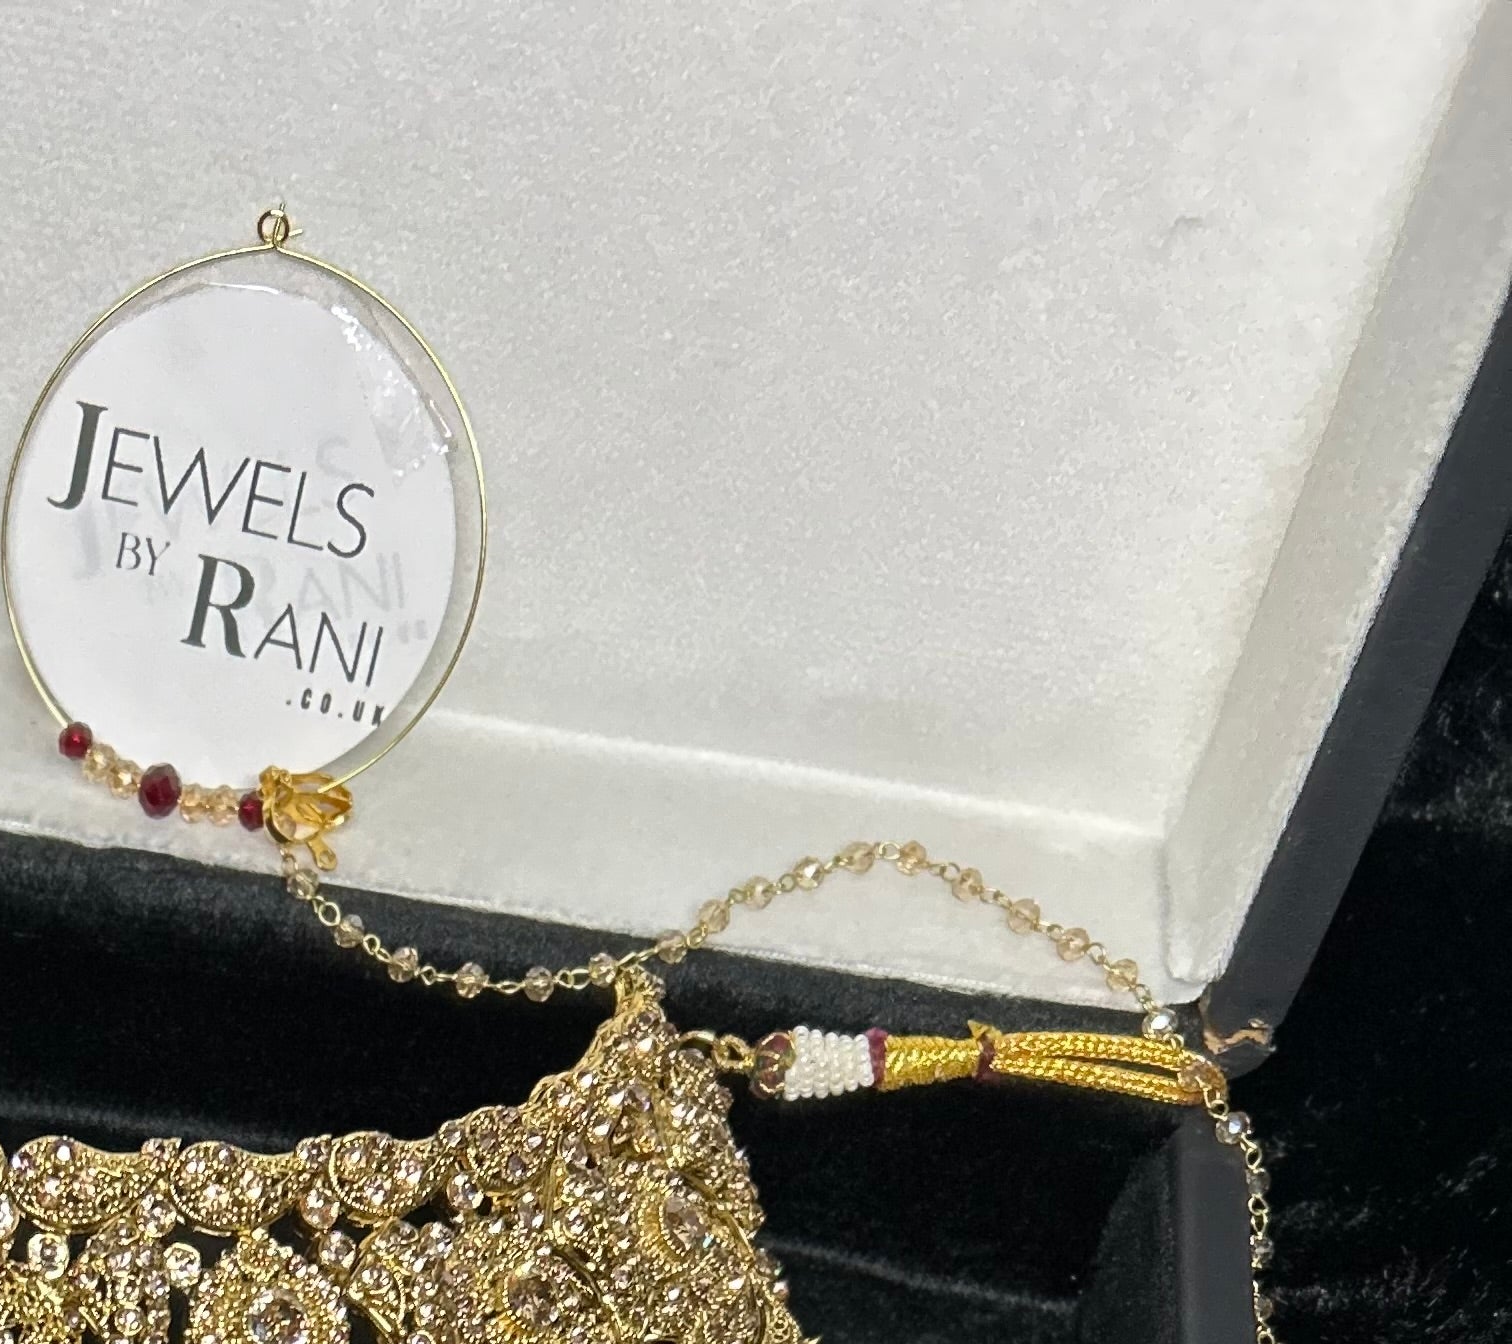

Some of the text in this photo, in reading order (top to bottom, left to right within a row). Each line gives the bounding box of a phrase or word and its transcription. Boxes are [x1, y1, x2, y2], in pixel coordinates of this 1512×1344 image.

[47, 400, 375, 559] JEWELS
[115, 531, 171, 576] BY
[180, 553, 384, 687] RANI
